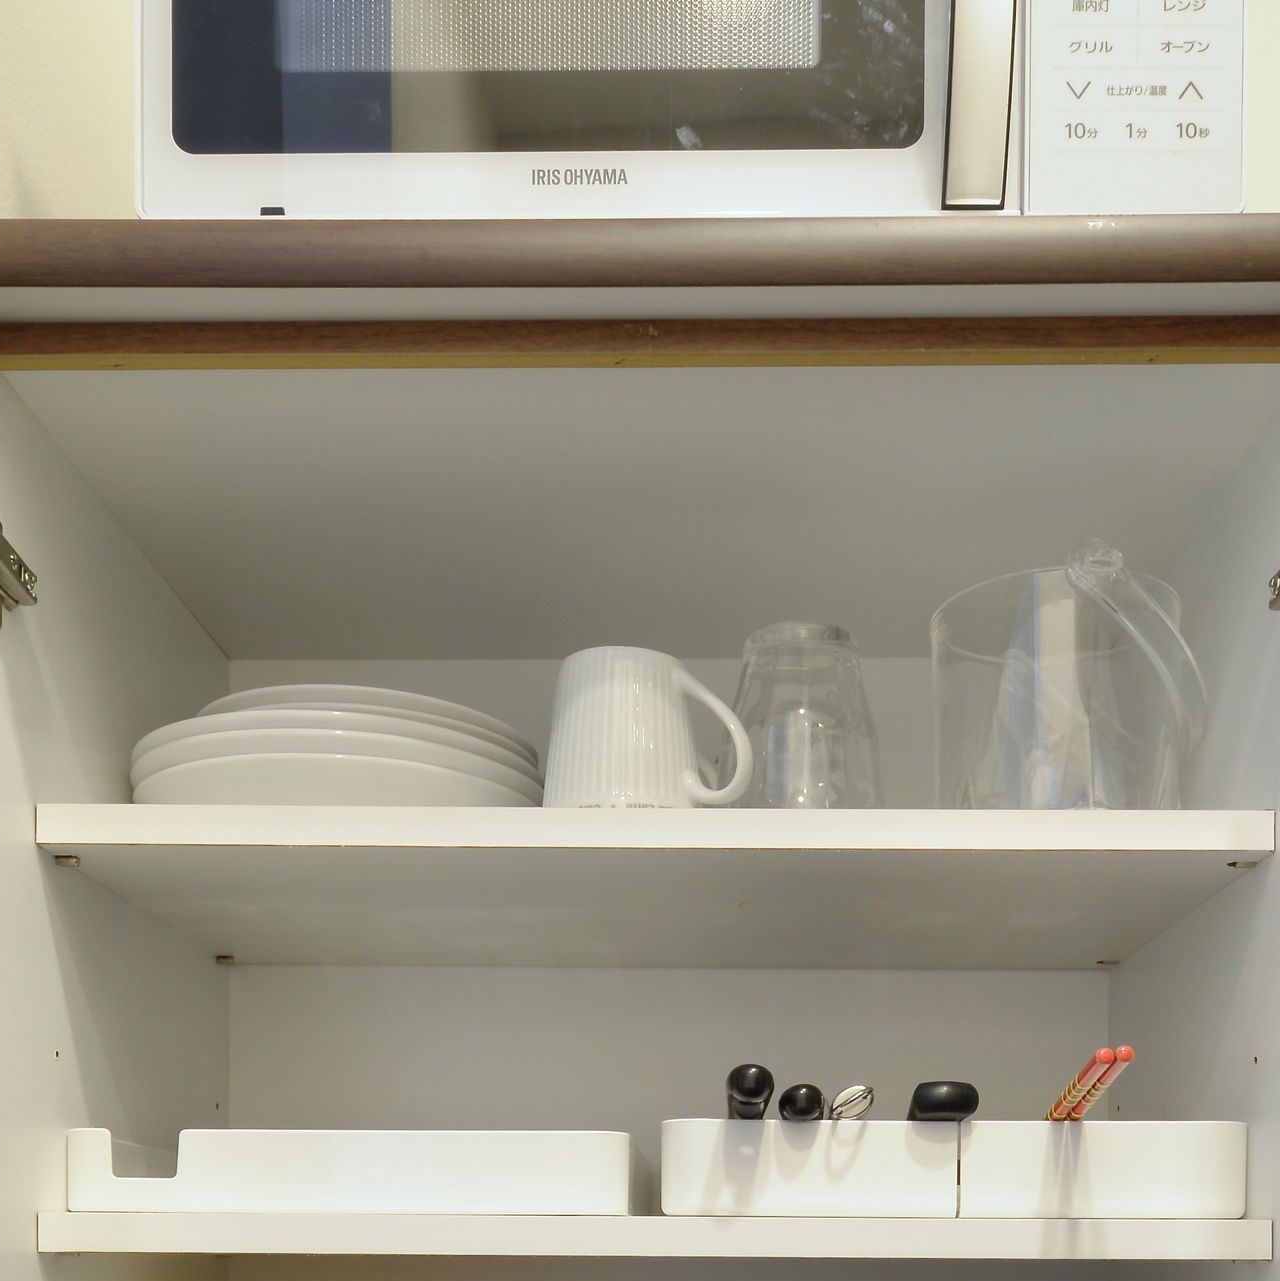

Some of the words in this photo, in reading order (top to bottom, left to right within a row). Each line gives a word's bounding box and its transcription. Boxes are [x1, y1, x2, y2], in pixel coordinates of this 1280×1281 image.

[1163, 0, 1206, 12] レンジ
[1069, 40, 1113, 54] グリル
[1160, 40, 1210, 54] オーブン
[1106, 84, 1167, 97] 仕上がり/温度
[1064, 122, 1098, 139] 10分
[1125, 122, 1148, 139] 1分
[1176, 122, 1210, 139] 10秒
[531, 168, 561, 186] IRIS
[563, 168, 628, 185] OHYAMA
